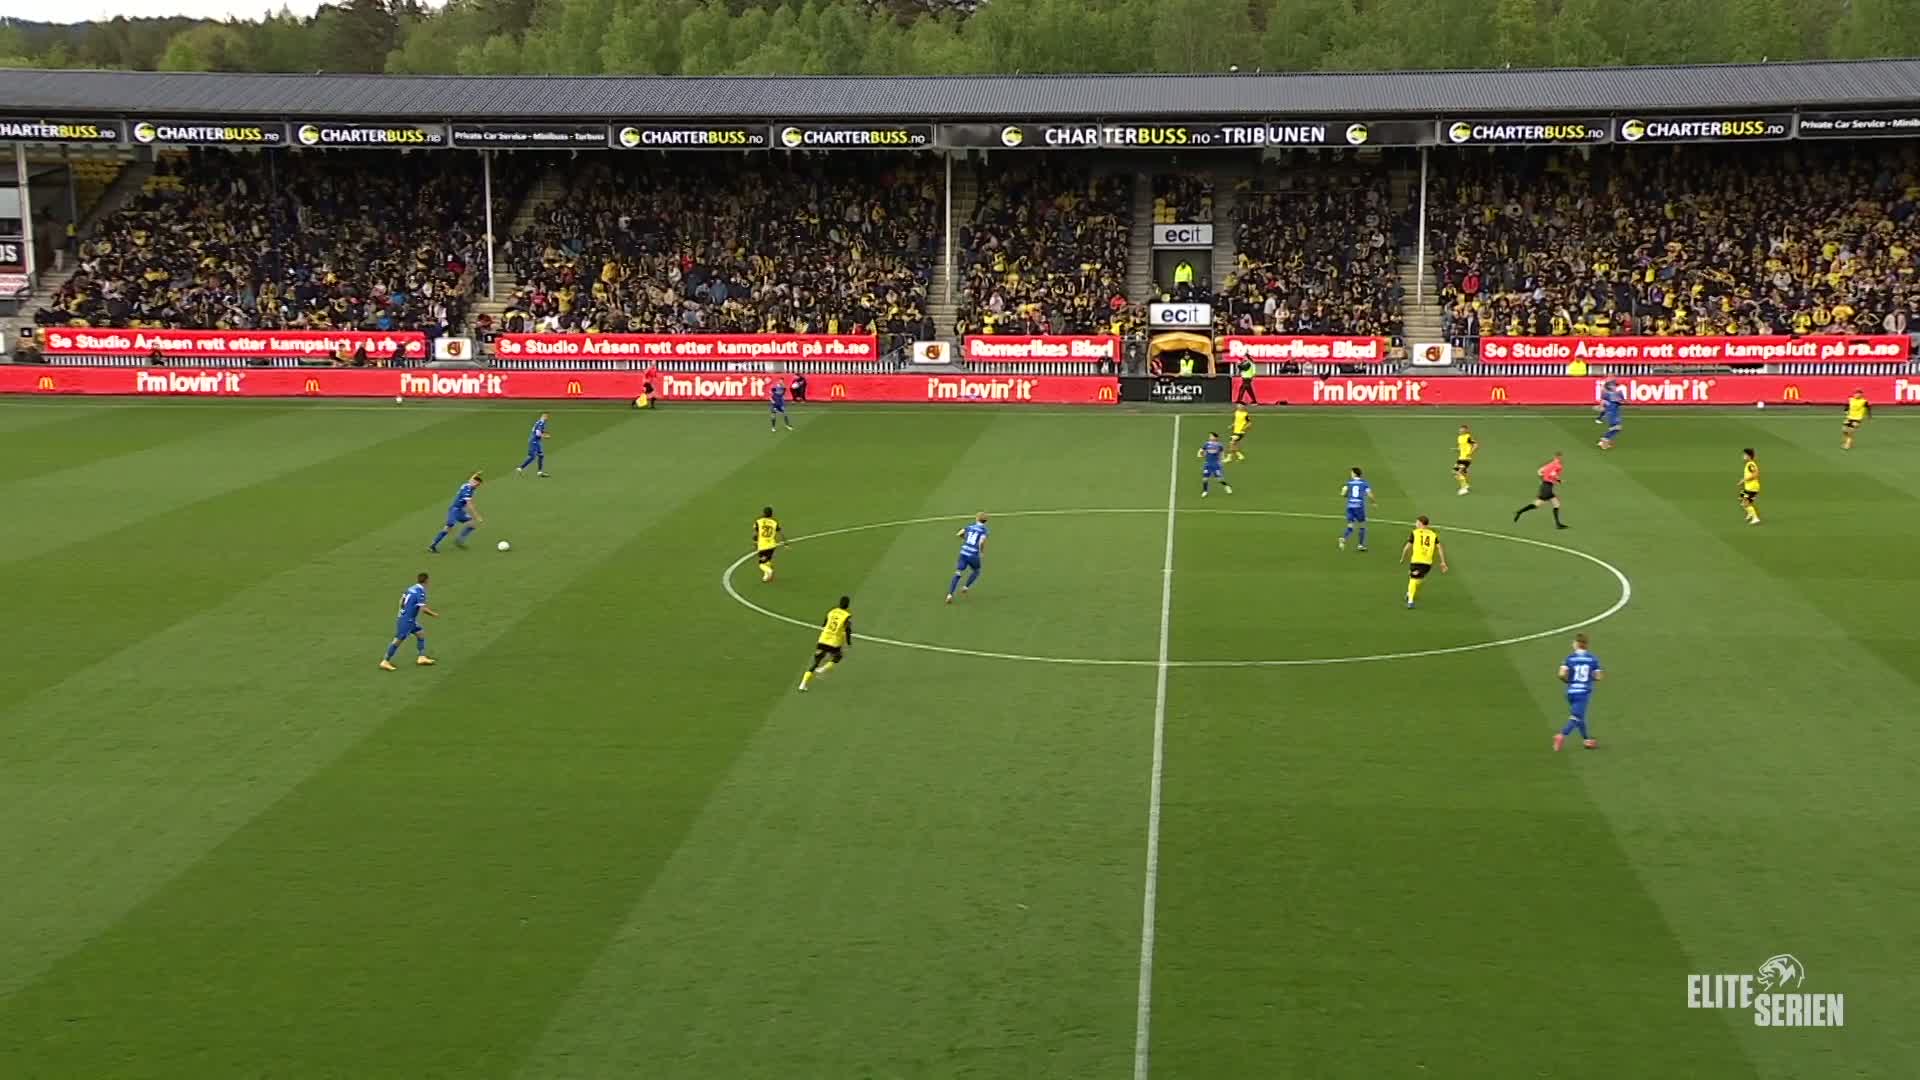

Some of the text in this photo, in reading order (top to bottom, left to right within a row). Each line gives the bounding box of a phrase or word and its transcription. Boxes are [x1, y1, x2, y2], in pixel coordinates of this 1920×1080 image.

[0, 123, 116, 139] HARTERBUSS.no
[157, 126, 280, 141] CHARTERBUSS.no
[321, 128, 442, 143] CHARTERBUSS.no
[642, 130, 764, 145] CHARTERBUSS.no
[804, 130, 926, 145] CHARTERBUSS.no
[1473, 124, 1604, 140] CHARTERBUSS.no
[1646, 120, 1785, 137] CHARTERBUSS.no
[1165, 226, 1202, 243] ecit
[1161, 305, 1200, 323] ecit
[50, 333, 72, 348] Se
[75, 333, 131, 349] Studio
[197, 336, 225, 350] rett
[229, 336, 266, 350] etter
[500, 338, 521, 354] Se
[525, 338, 578, 354] Studio
[645, 339, 671, 354] rett
[675, 340, 713, 354] etter
[717, 339, 798, 357] kampslutt
[803, 339, 823, 358] på
[825, 338, 870, 355] rb.no
[970, 339, 1069, 357] Romerikes
[1229, 340, 1330, 359] Romerikes
[1484, 342, 1508, 358] Se
[1512, 342, 1571, 358] Studio
[1643, 342, 1674, 358] rett
[1678, 342, 1721, 358] etter
[1725, 341, 1817, 360] kampslutt
[1821, 341, 1845, 360] på
[136, 371, 240, 392] i'm lovin' it
[400, 373, 502, 394] i'm lovin' it
[662, 376, 765, 396] i'm lovin' it
[927, 378, 1032, 399] i'm lovin' it
[1152, 381, 1202, 395] åråsen
[1313, 380, 1421, 401] i'm lovin' it
[1631, 379, 1689, 401] lovin'
[1692, 379, 1708, 400] it
[1420, 535, 1431, 548] 14
[1573, 664, 1590, 682] 19
